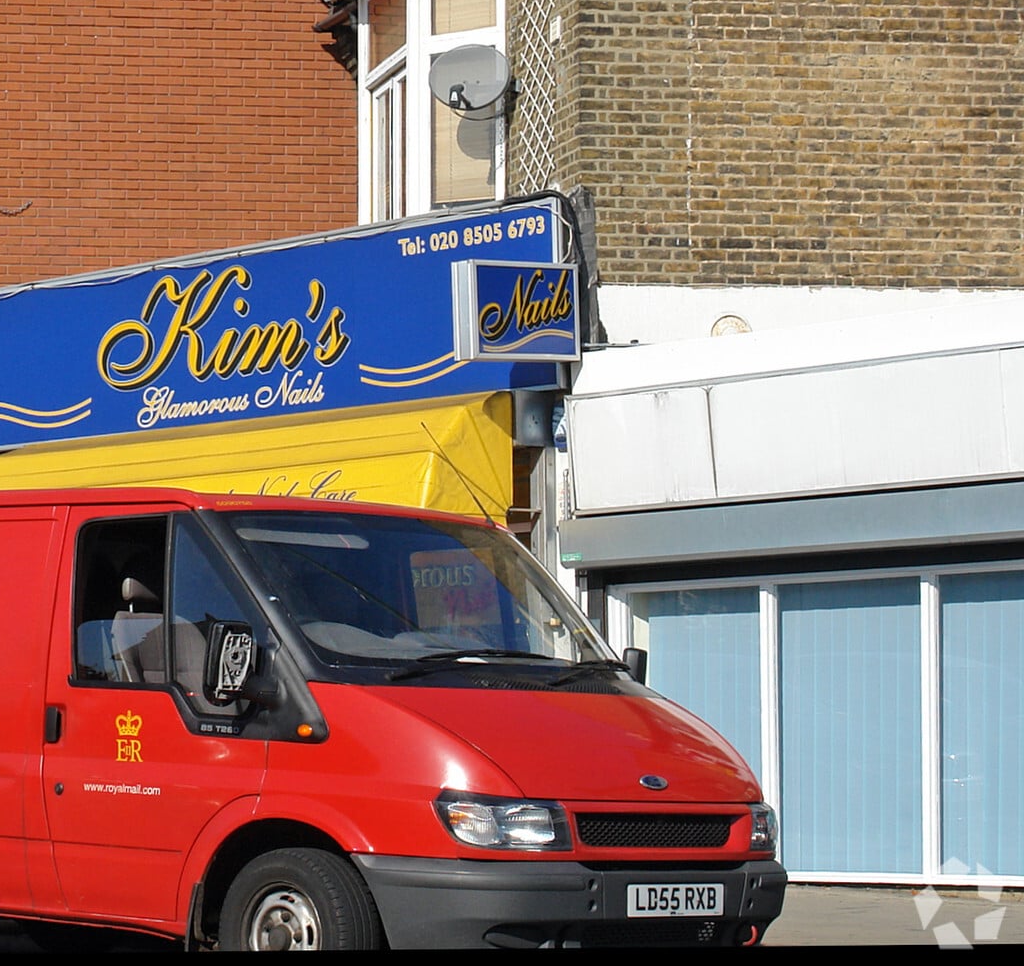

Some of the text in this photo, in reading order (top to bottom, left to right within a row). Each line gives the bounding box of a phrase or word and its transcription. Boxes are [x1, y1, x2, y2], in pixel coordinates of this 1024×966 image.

[397, 215, 545, 257] Tel: 020 8505 6793
[97, 265, 351, 393] Kim's
[479, 269, 574, 342] Nails
[136, 370, 325, 429] Glamorous Nails
[83, 783, 161, 796] www.royalmail.com
[635, 886, 717, 911] LD55 RXB
